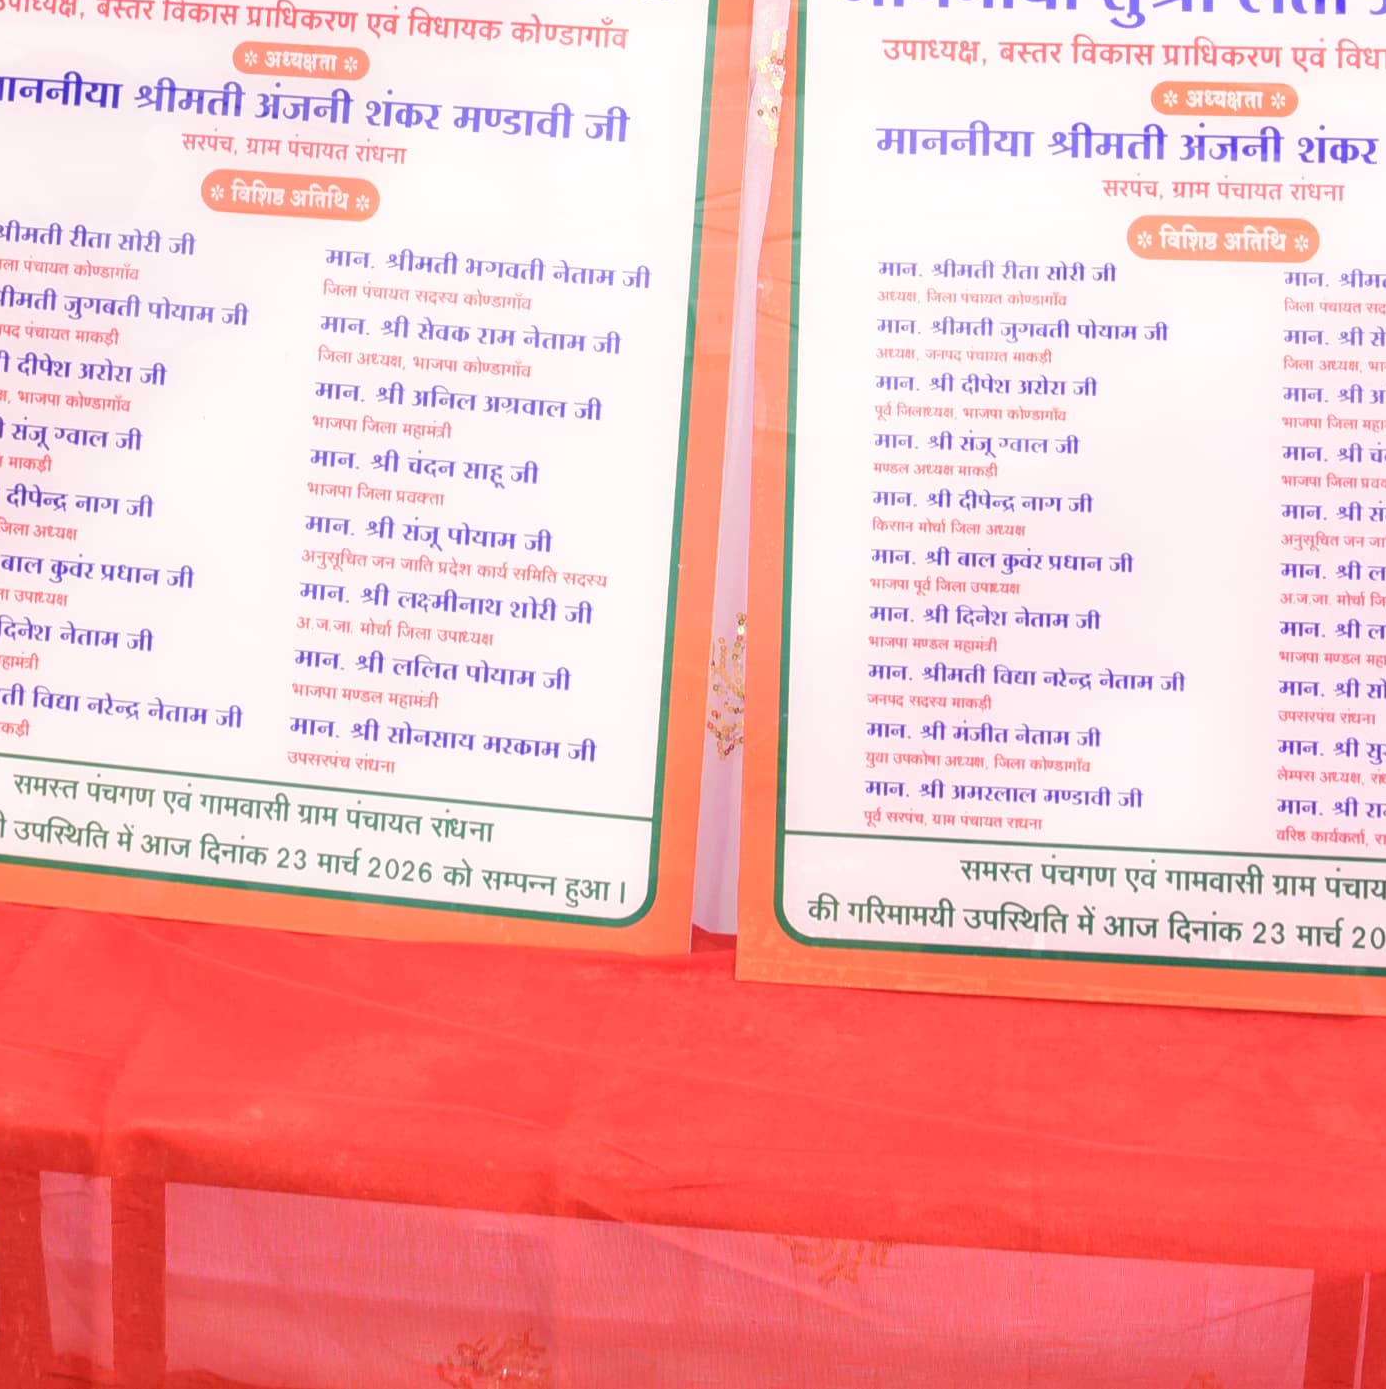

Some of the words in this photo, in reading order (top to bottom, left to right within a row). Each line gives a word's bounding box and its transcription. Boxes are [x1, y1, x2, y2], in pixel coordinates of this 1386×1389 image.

[882, 39, 986, 65] उपाध्यक्ष,
[998, 41, 1063, 63] बस्तर
[1070, 33, 1155, 66] विकास
[1161, 35, 1282, 68] प्राधिकरण
[1290, 38, 1327, 73] एवं
[134, 77, 245, 116] श्रीमती
[255, 82, 354, 124] अंजनी
[366, 89, 442, 129] शंकर
[453, 102, 574, 138] मण्डावी
[585, 106, 630, 142] जी
[1223, 224, 1287, 251] अतिथि
[371, 449, 400, 472] श्री
[408, 450, 456, 477] चंदन
[463, 462, 505, 489] साहू
[511, 460, 539, 484] जी
[13, 774, 79, 800] समस्त
[86, 773, 155, 808] पंचगण
[163, 782, 192, 814] एवं
[297, 804, 338, 827] ग्राम
[346, 800, 423, 835] पंचायत
[430, 808, 494, 842] रांधना
